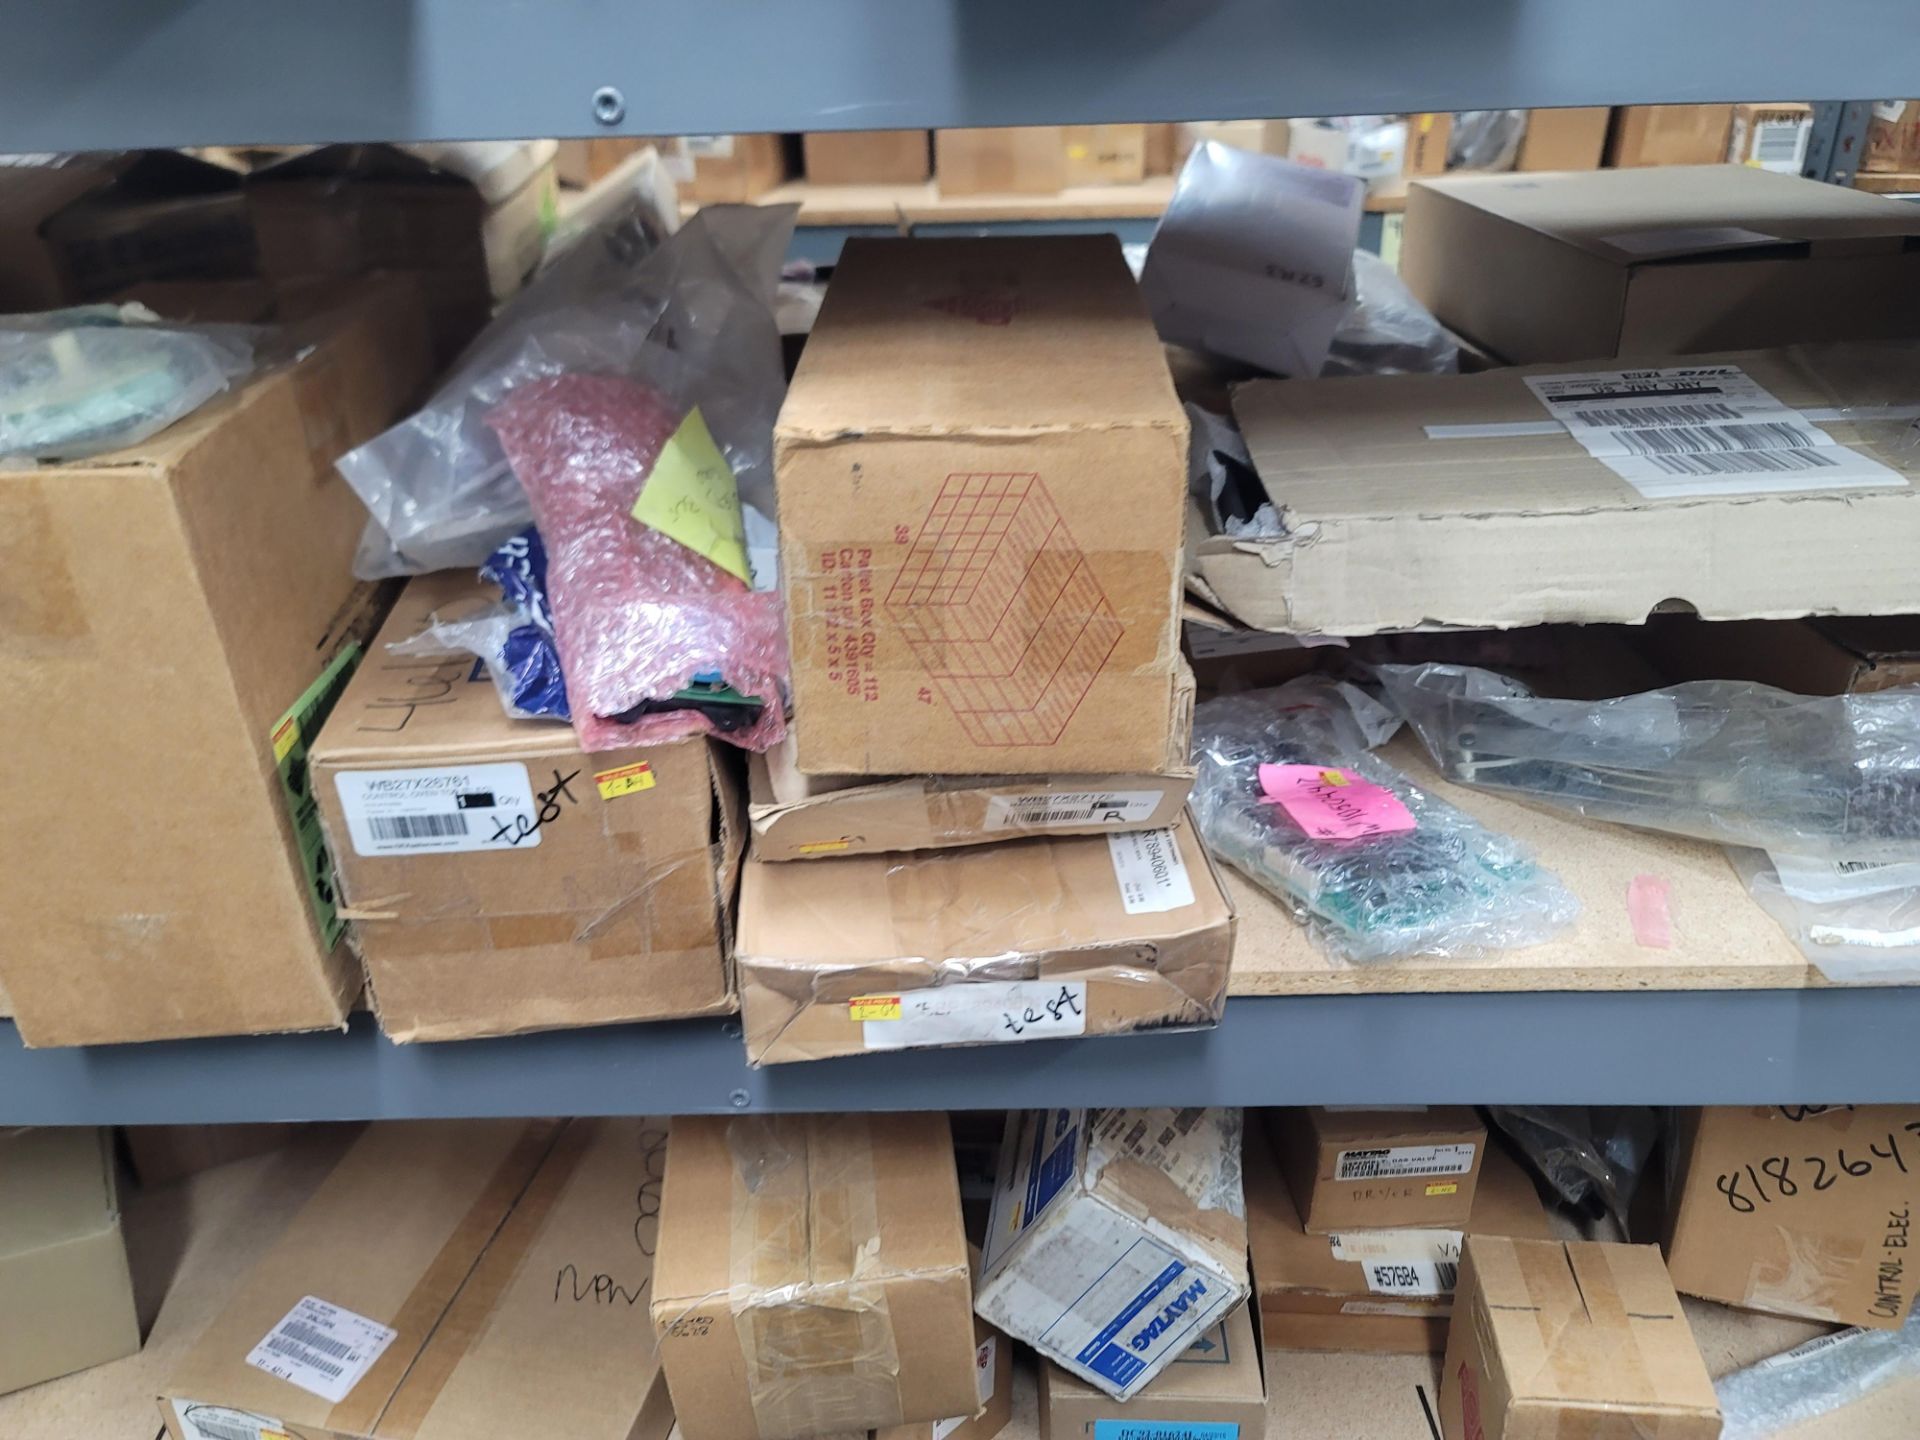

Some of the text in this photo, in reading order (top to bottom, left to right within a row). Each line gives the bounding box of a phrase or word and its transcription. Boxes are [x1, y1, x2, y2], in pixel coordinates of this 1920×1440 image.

[860, 598, 875, 628] Box
[861, 632, 877, 657] Qty
[863, 677, 879, 702] 112
[1103, 810, 1126, 823] R
[1003, 986, 1082, 1034] test
[1373, 1265, 1420, 1287] #57684
[1130, 1278, 1208, 1352] MAYTAG
